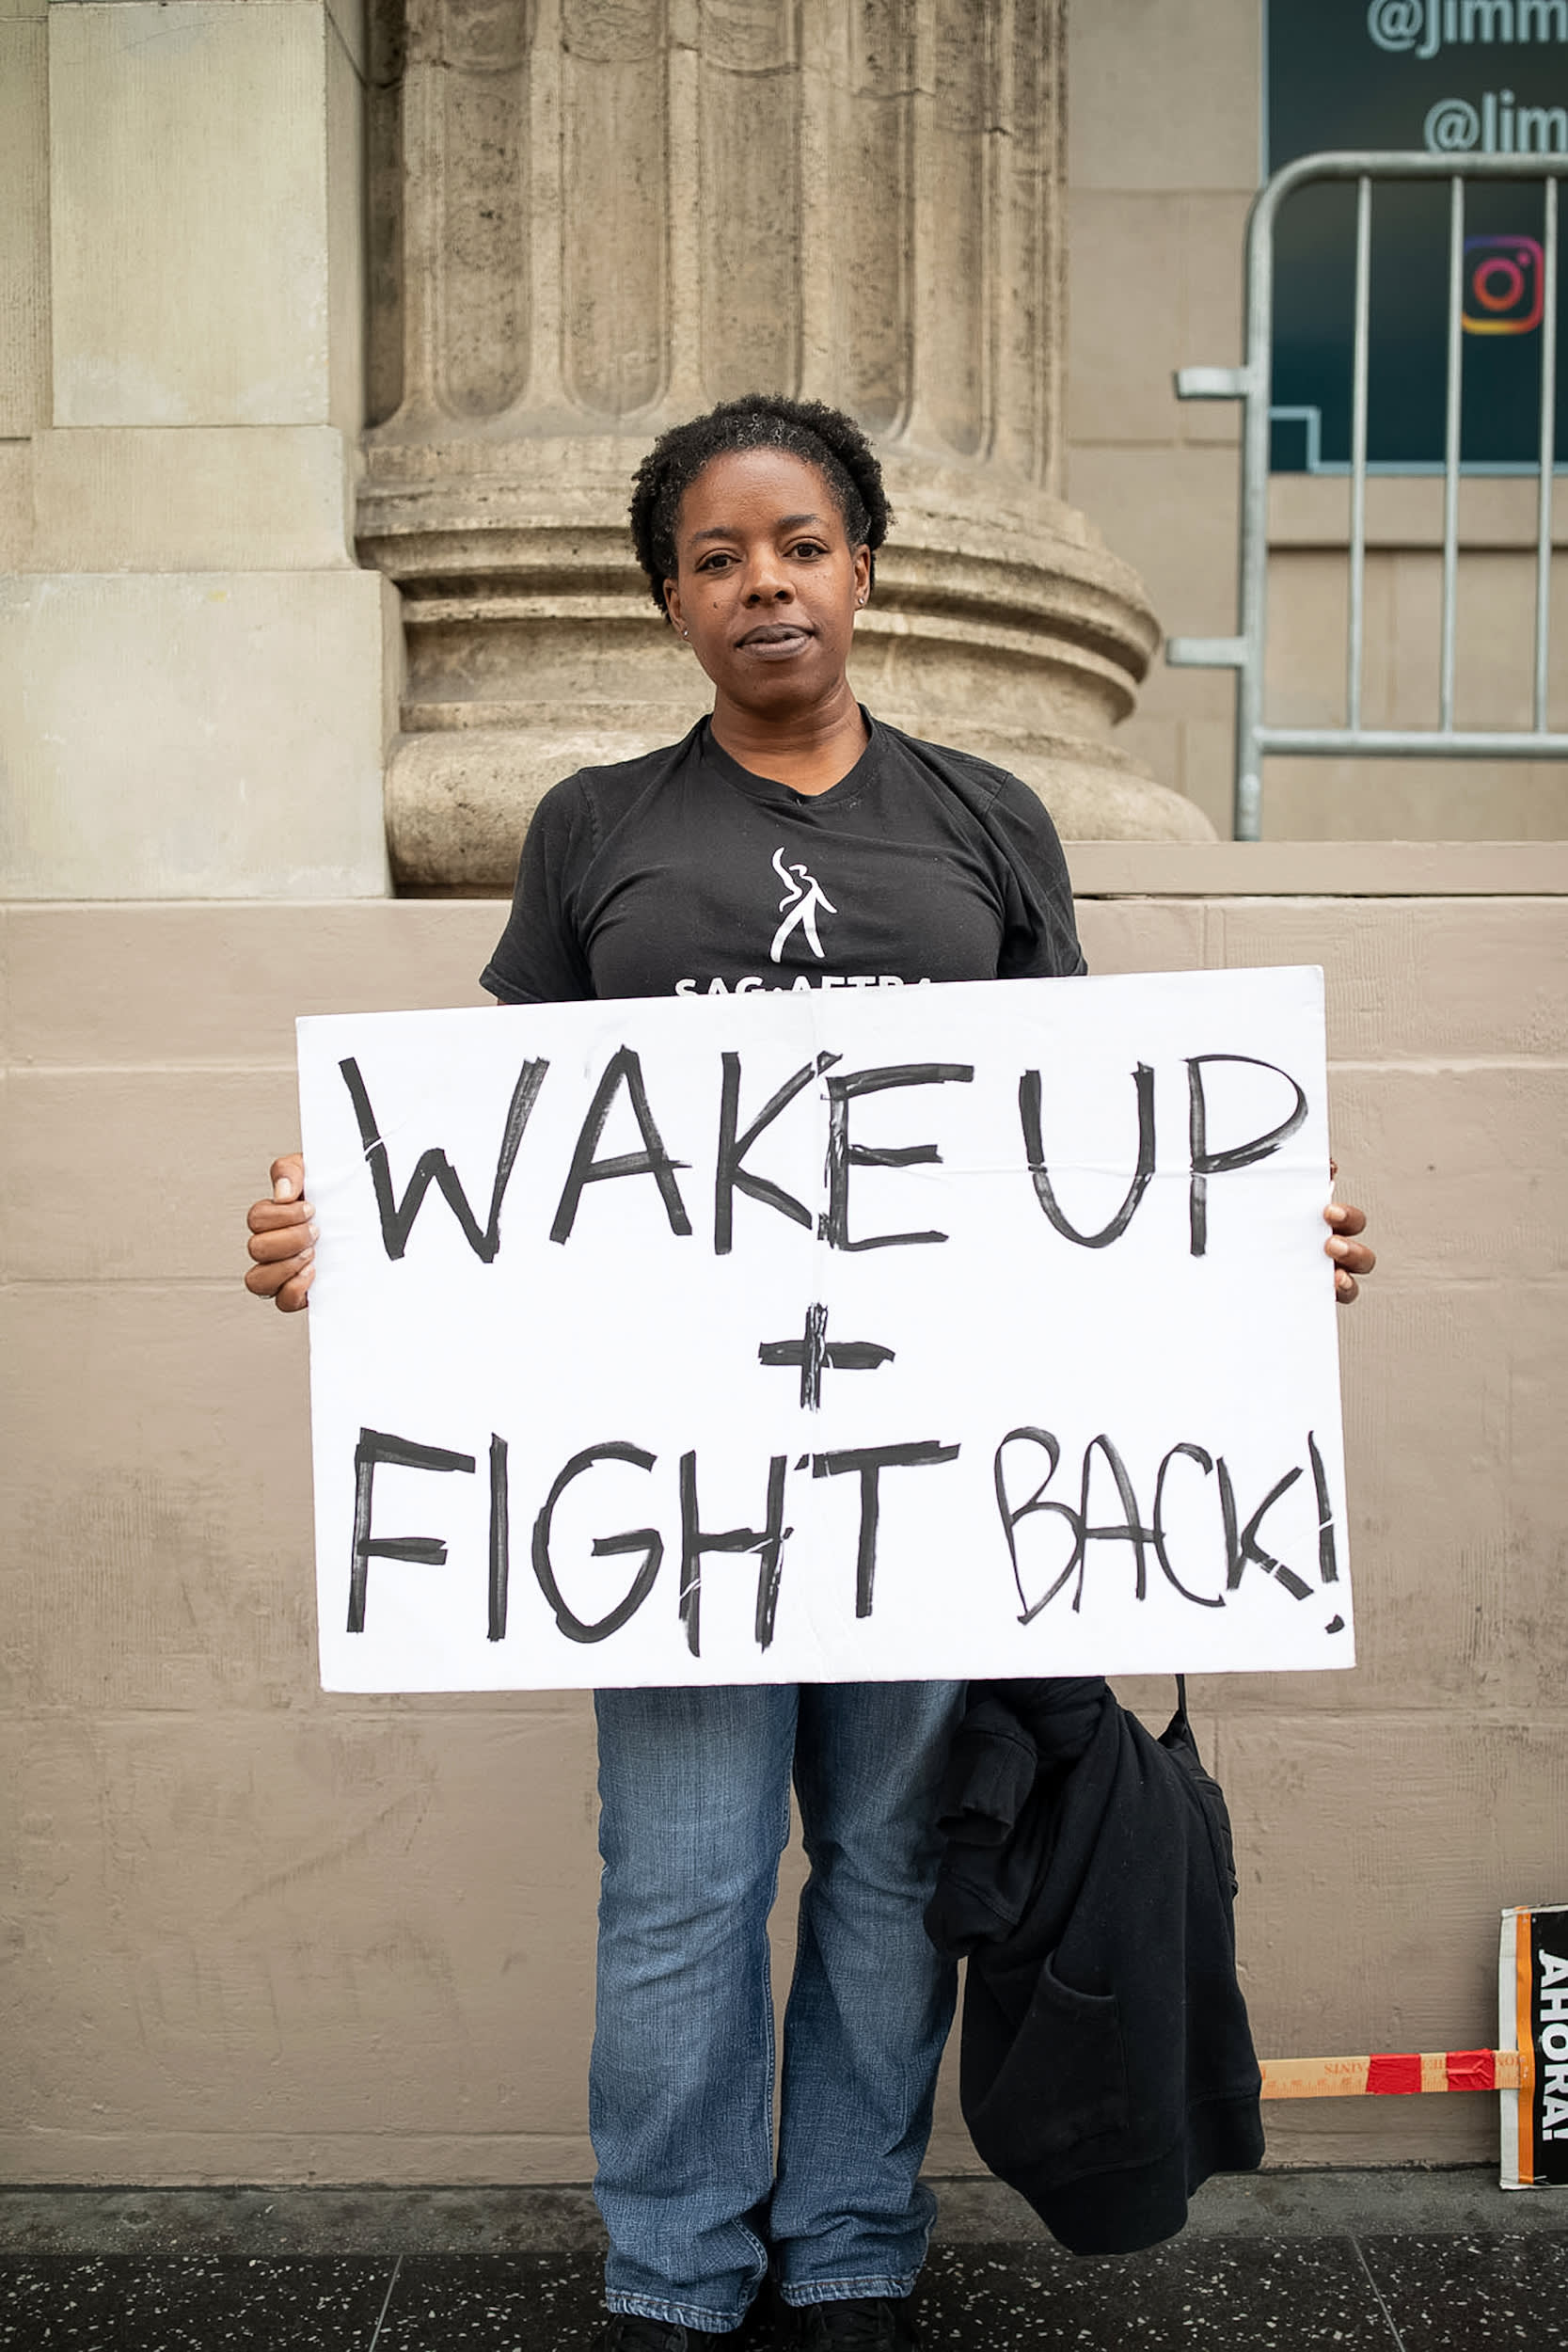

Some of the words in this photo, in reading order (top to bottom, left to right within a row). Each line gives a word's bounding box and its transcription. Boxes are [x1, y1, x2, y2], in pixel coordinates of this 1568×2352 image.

[339, 1044, 974, 1263] WAKE
[1019, 1055, 1307, 1257] UP
[758, 1303, 895, 1409] +
[346, 1427, 960, 1657] FIGHT
[994, 1427, 1345, 1635] BACK!
[1538, 1949, 1568, 2142] AHORA!
